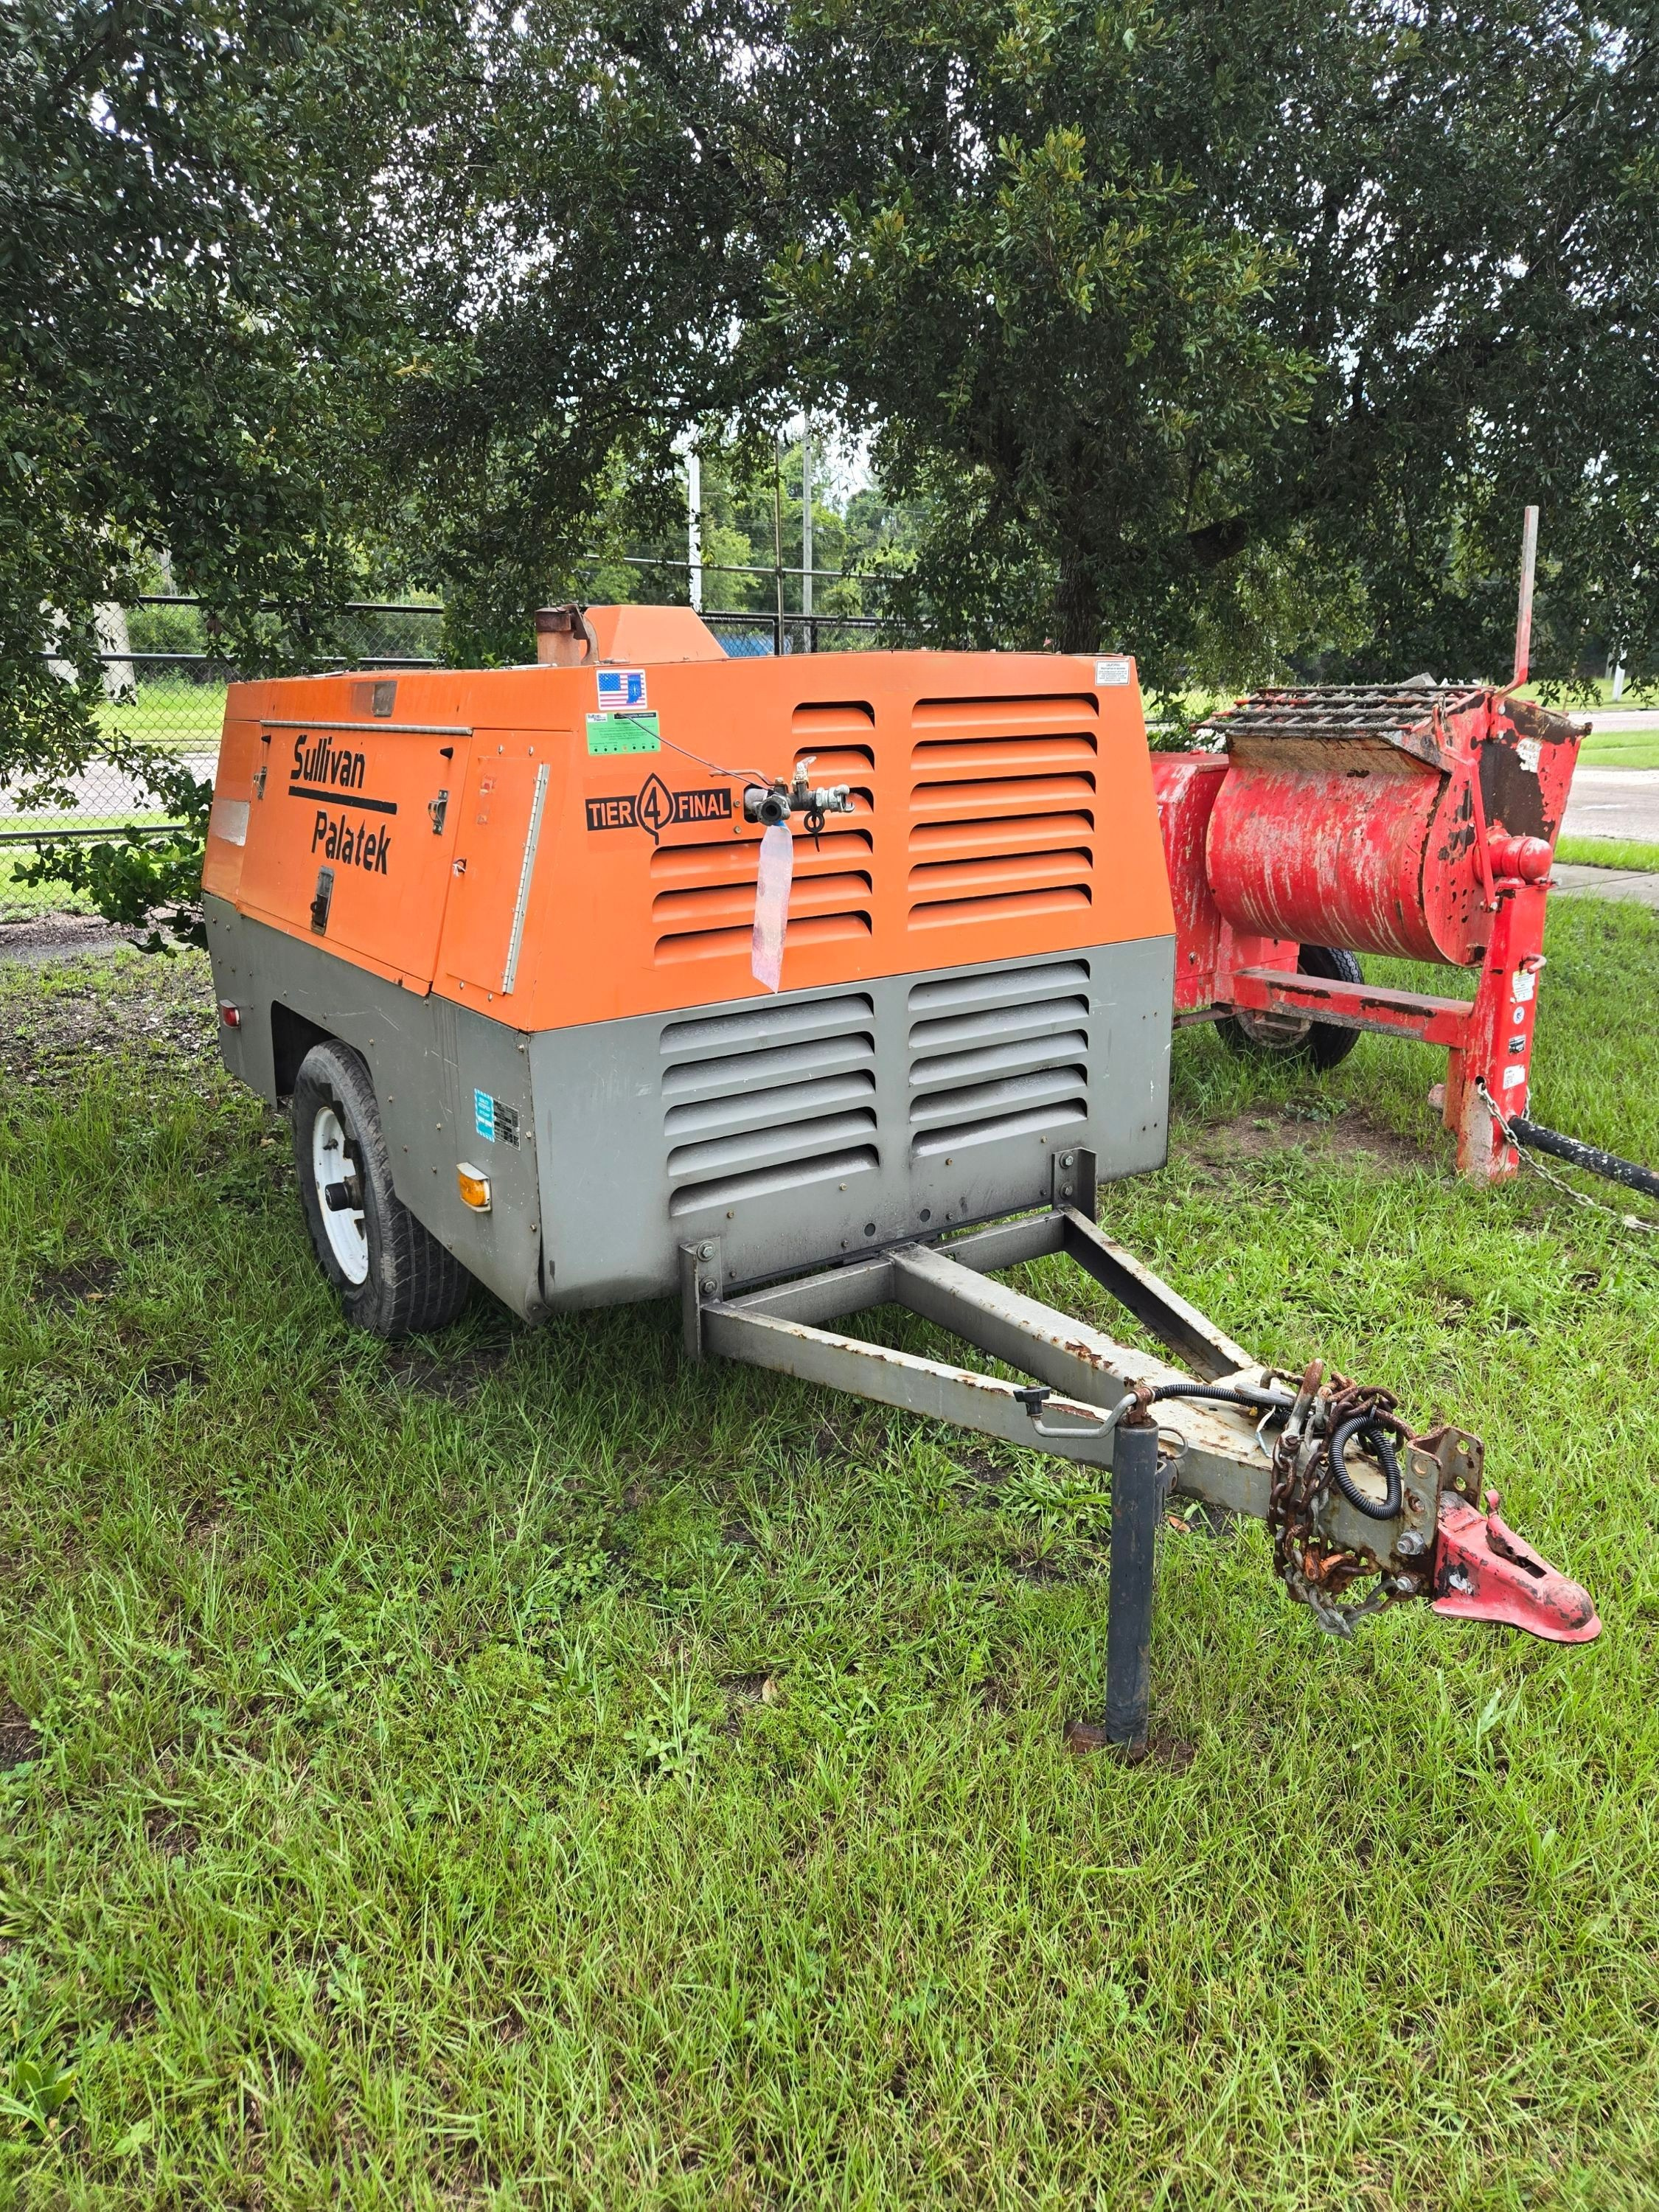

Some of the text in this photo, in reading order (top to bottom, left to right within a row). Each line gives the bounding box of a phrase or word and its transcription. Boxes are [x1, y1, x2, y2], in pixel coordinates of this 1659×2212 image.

[291, 734, 365, 789] Sullivan
[588, 786, 730, 827] TIER 4 FINAL
[311, 810, 392, 875] Palatek
